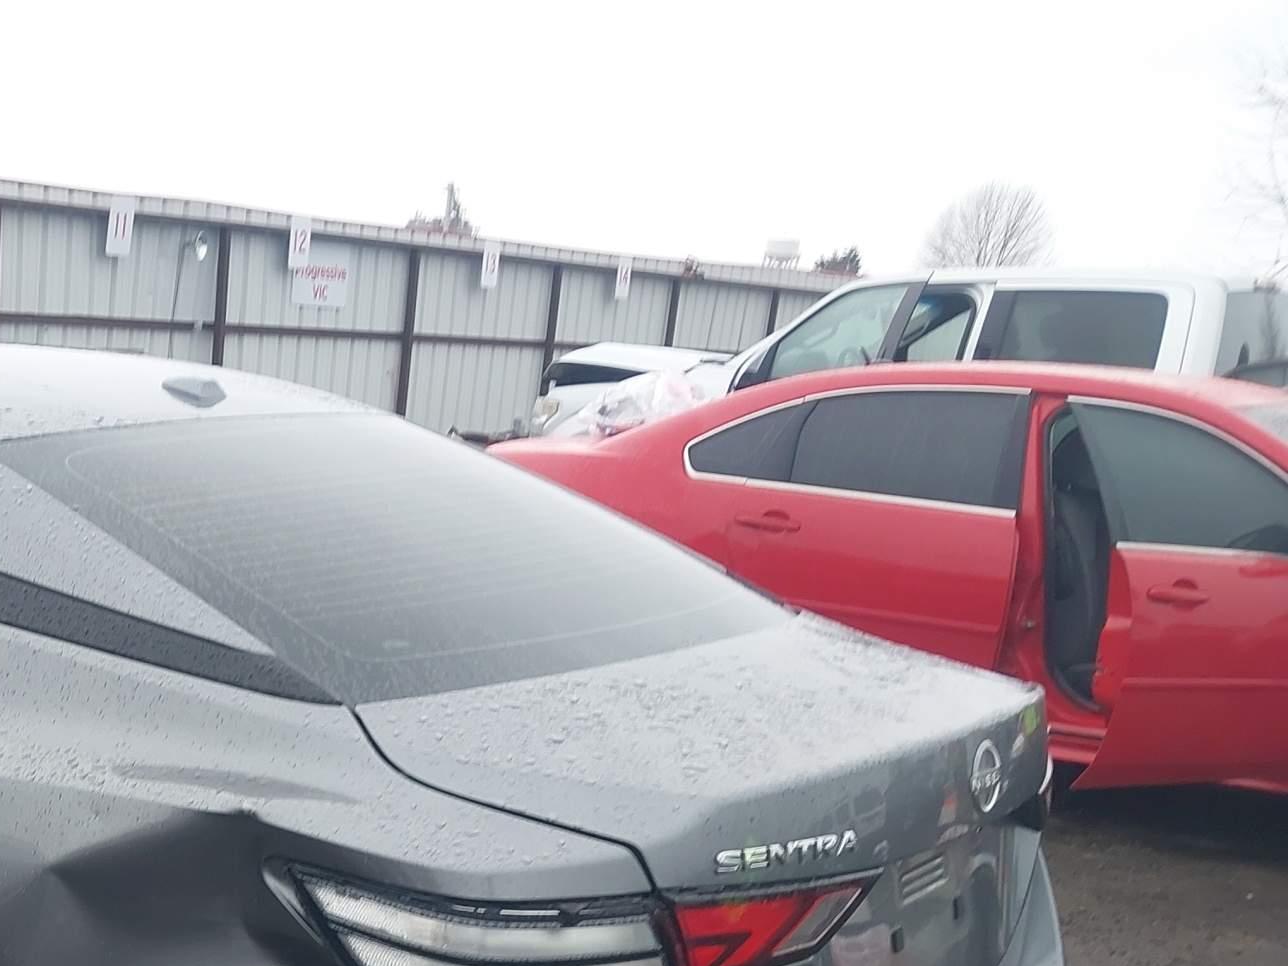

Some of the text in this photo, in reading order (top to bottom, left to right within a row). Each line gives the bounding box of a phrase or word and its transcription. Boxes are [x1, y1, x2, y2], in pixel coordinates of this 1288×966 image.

[113, 211, 128, 241] 11
[293, 228, 308, 254] 12
[714, 829, 859, 875] SENTRA
